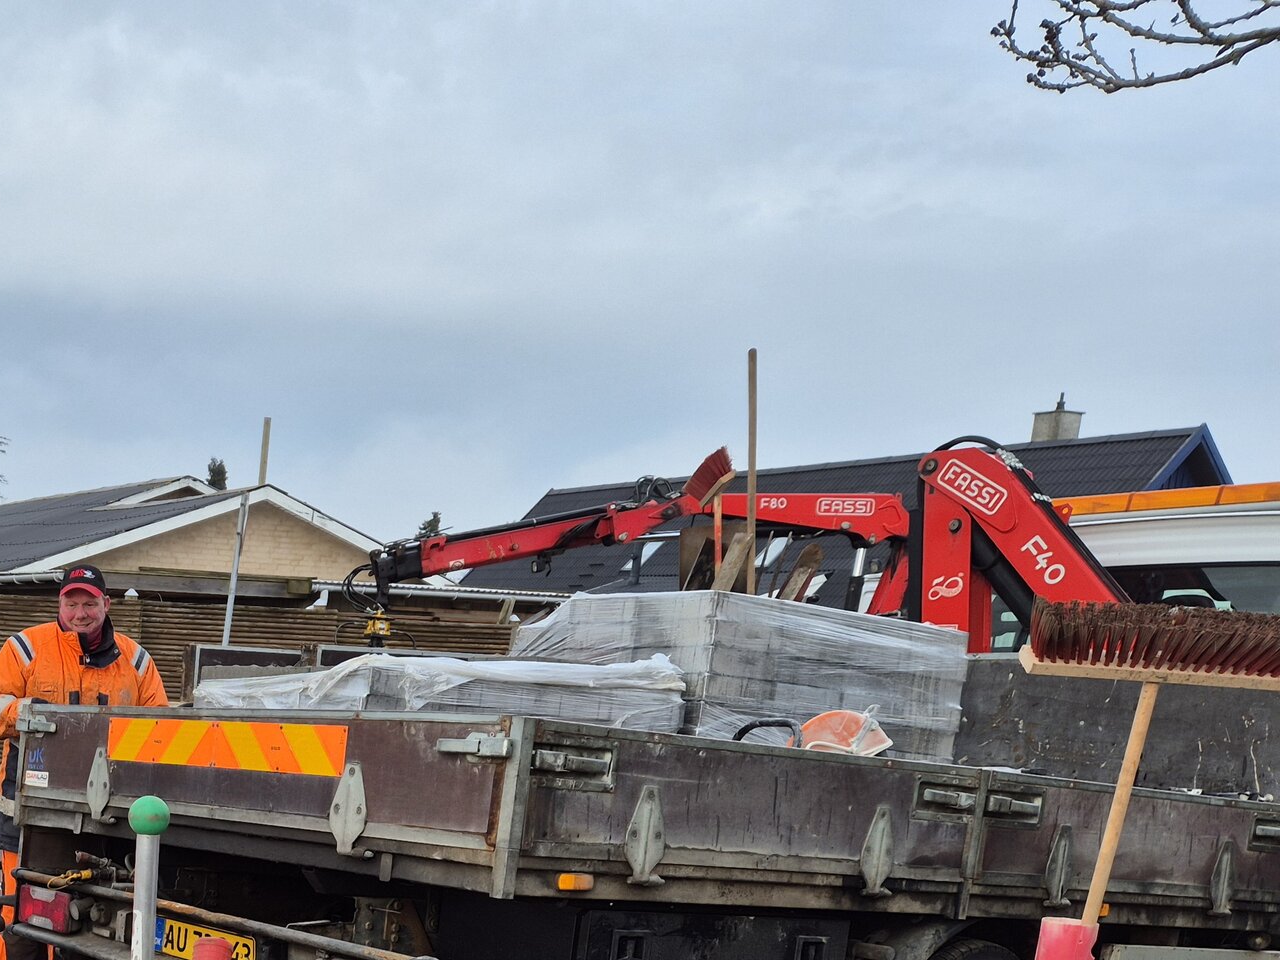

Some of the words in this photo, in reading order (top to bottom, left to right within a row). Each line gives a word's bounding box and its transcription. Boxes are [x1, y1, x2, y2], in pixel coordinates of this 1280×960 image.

[944, 465, 1000, 508] FASSI
[760, 497, 787, 510] F80
[820, 500, 871, 513] FASSI
[1020, 535, 1066, 585] F40
[164, 924, 188, 952] AU
